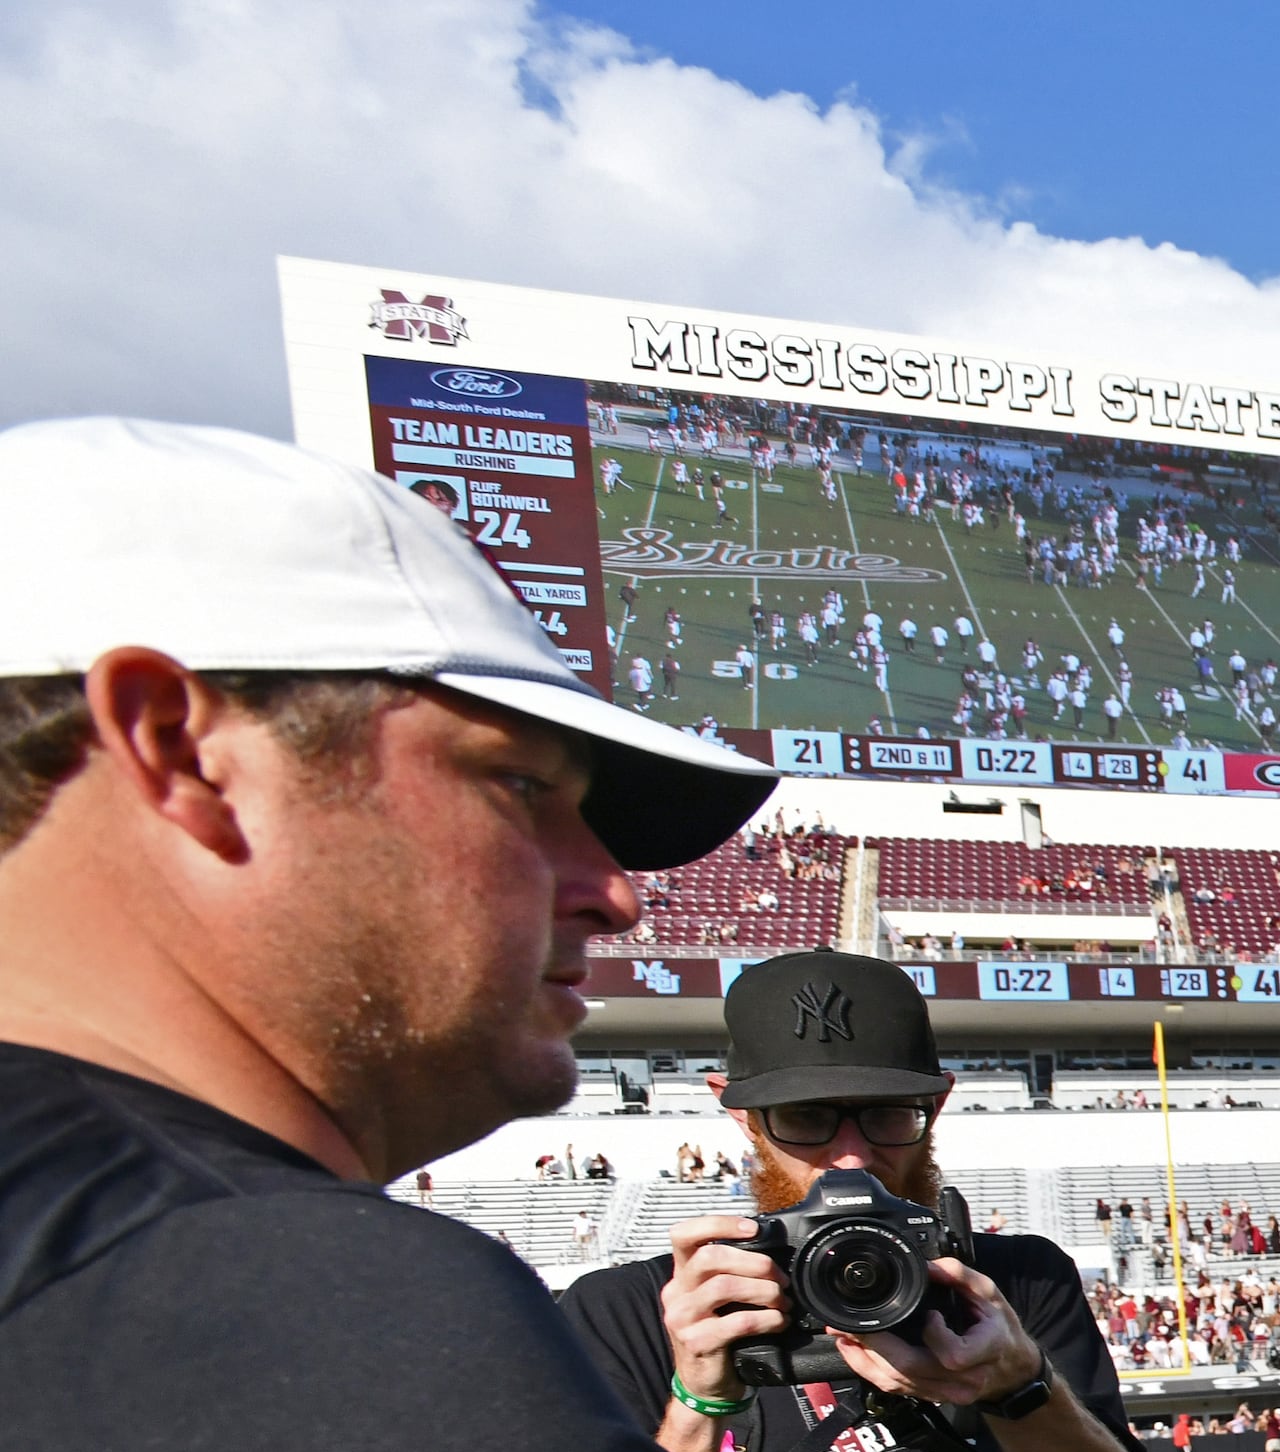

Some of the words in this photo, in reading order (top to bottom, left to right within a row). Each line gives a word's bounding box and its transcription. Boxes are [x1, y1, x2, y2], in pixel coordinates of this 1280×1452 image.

[627, 316, 1075, 417] MISSISSIPPI
[449, 372, 506, 396] Ford
[410, 398, 473, 413] Mid-South
[475, 405, 501, 417] Ford
[502, 407, 546, 421] Dealers
[388, 417, 460, 446] TEAM
[465, 425, 573, 457] LEADERS
[455, 453, 516, 470] RUSHING
[469, 480, 502, 494] FLUFF
[470, 493, 551, 513] BOTHWELL
[474, 511, 532, 548] 24
[545, 587, 581, 600] YARDS
[793, 739, 823, 764] 21
[876, 747, 912, 764] 2ND
[918, 751, 928, 765] &
[934, 751, 946, 766] 11
[976, 747, 1038, 774] 0:22
[1076, 758, 1086, 771] 4
[1110, 758, 1132, 774] 28
[1183, 758, 1208, 782] 41
[994, 968, 1053, 992] 0:22
[1116, 974, 1127, 988] 4
[1176, 973, 1201, 991] 28
[1253, 970, 1280, 996] 41
[825, 1196, 873, 1207] Canon
